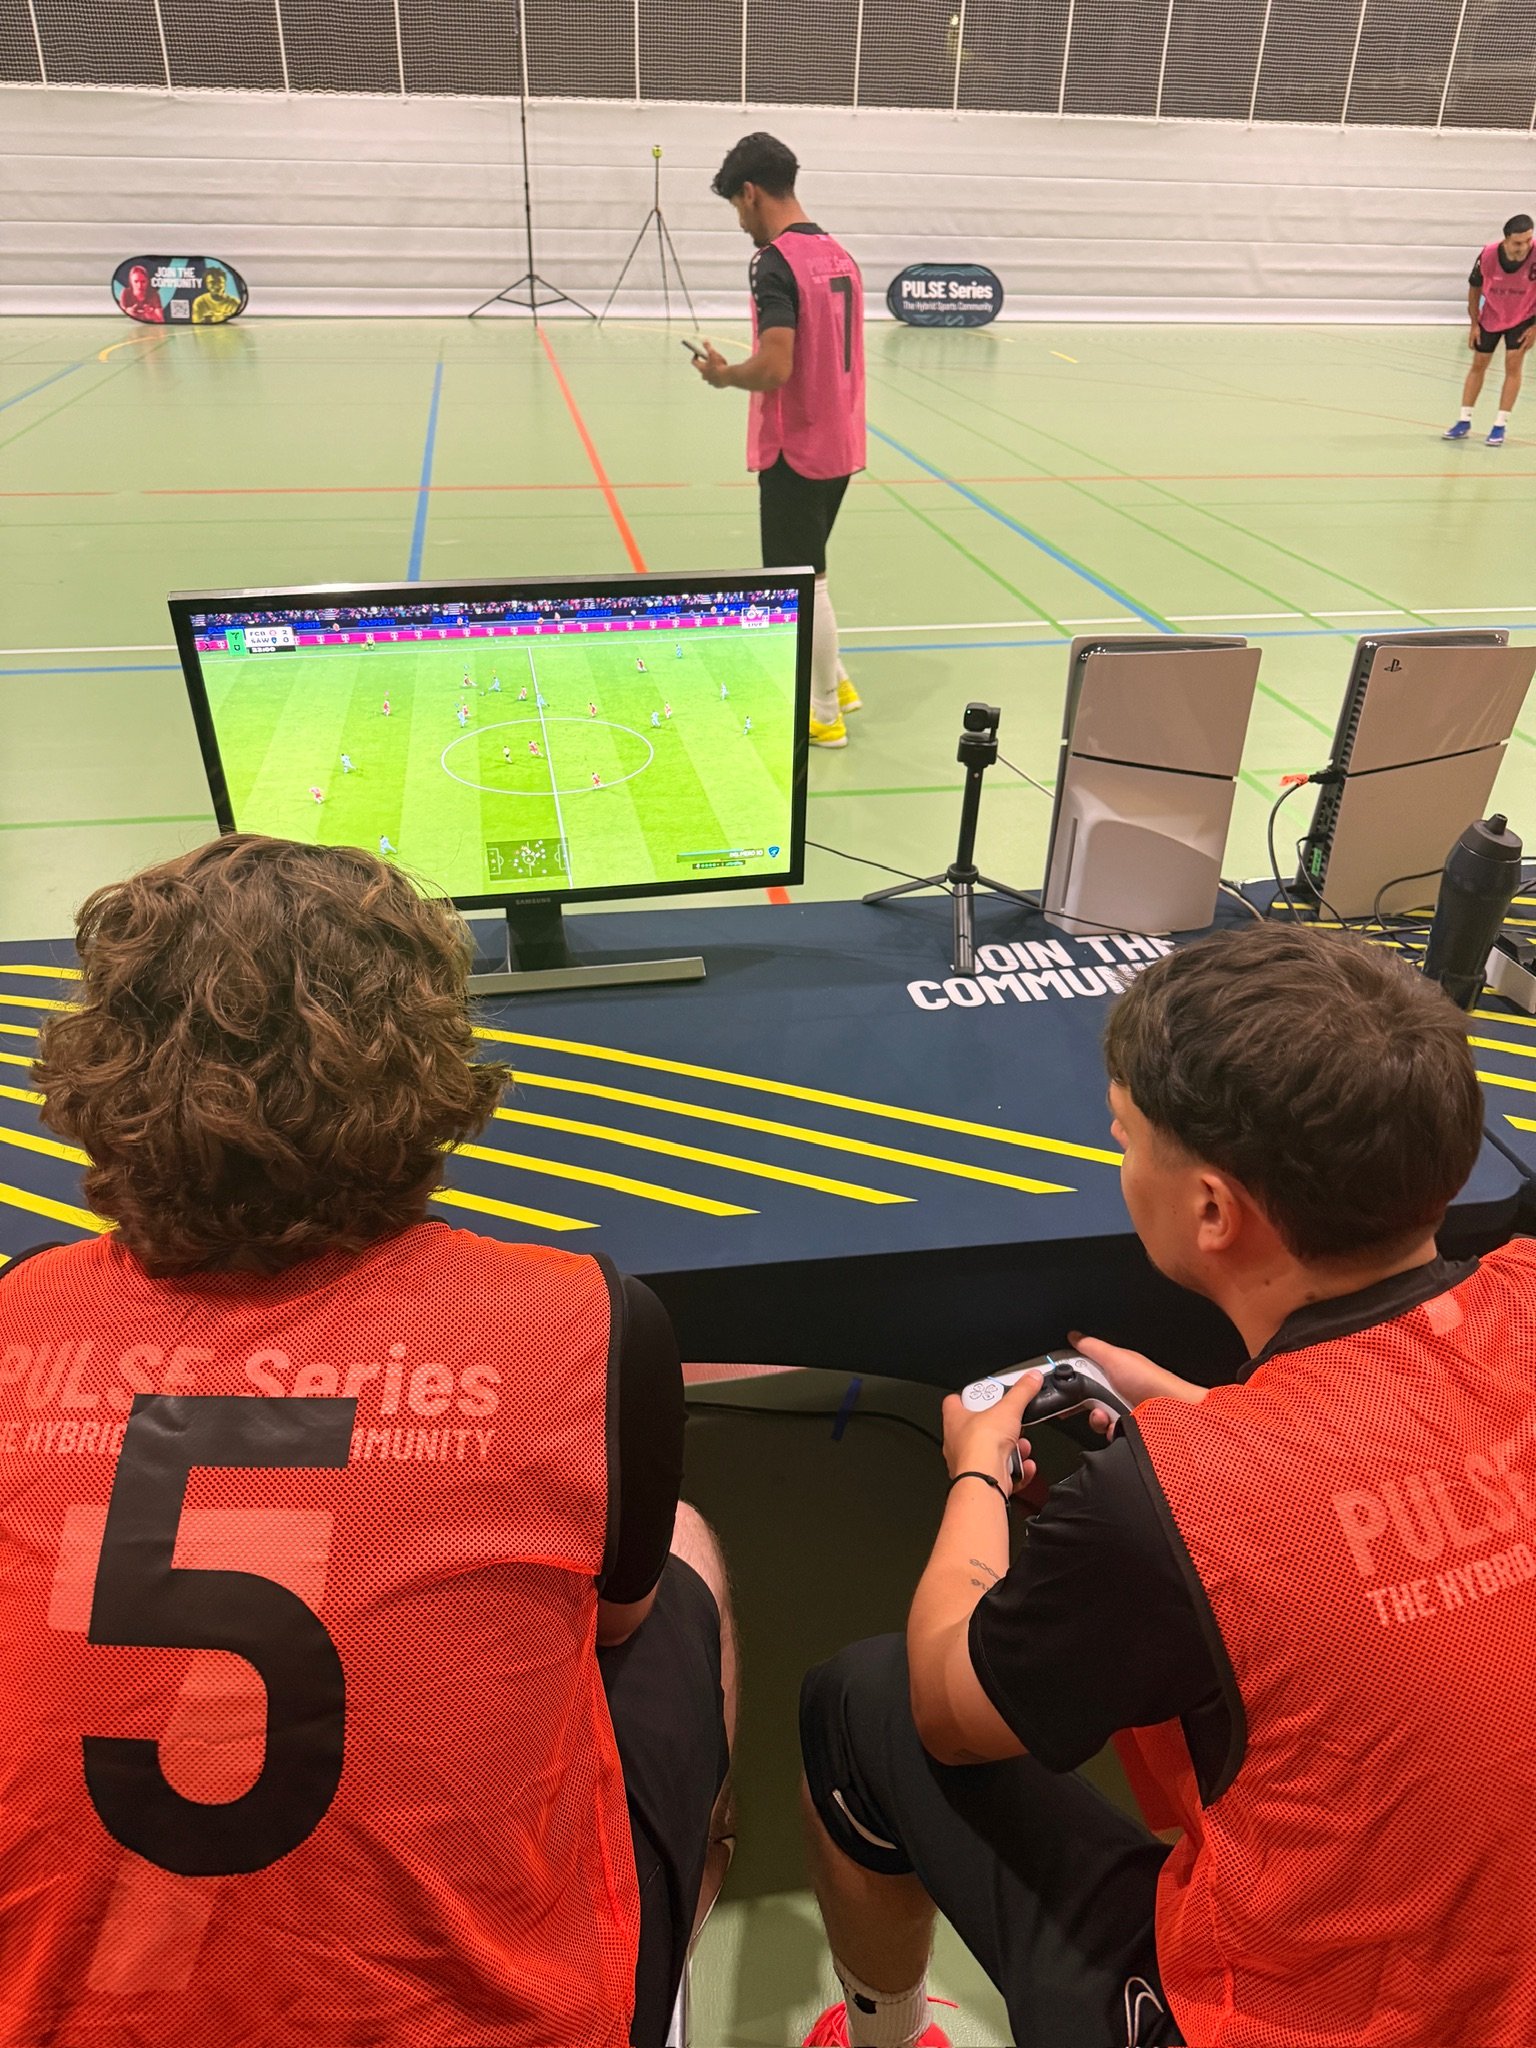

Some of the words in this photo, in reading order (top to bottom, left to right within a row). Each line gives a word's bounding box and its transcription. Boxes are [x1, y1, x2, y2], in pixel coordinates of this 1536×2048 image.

[151, 278, 202, 288] COMMUNITY
[155, 267, 176, 278] JOIN
[179, 267, 195, 278] THE
[902, 281, 946, 298] PULSE
[949, 281, 993, 299] Series
[907, 961, 1158, 1011] COMMUN
[1366, 1579, 1437, 1626] THE
[81, 1394, 358, 1876] 5
